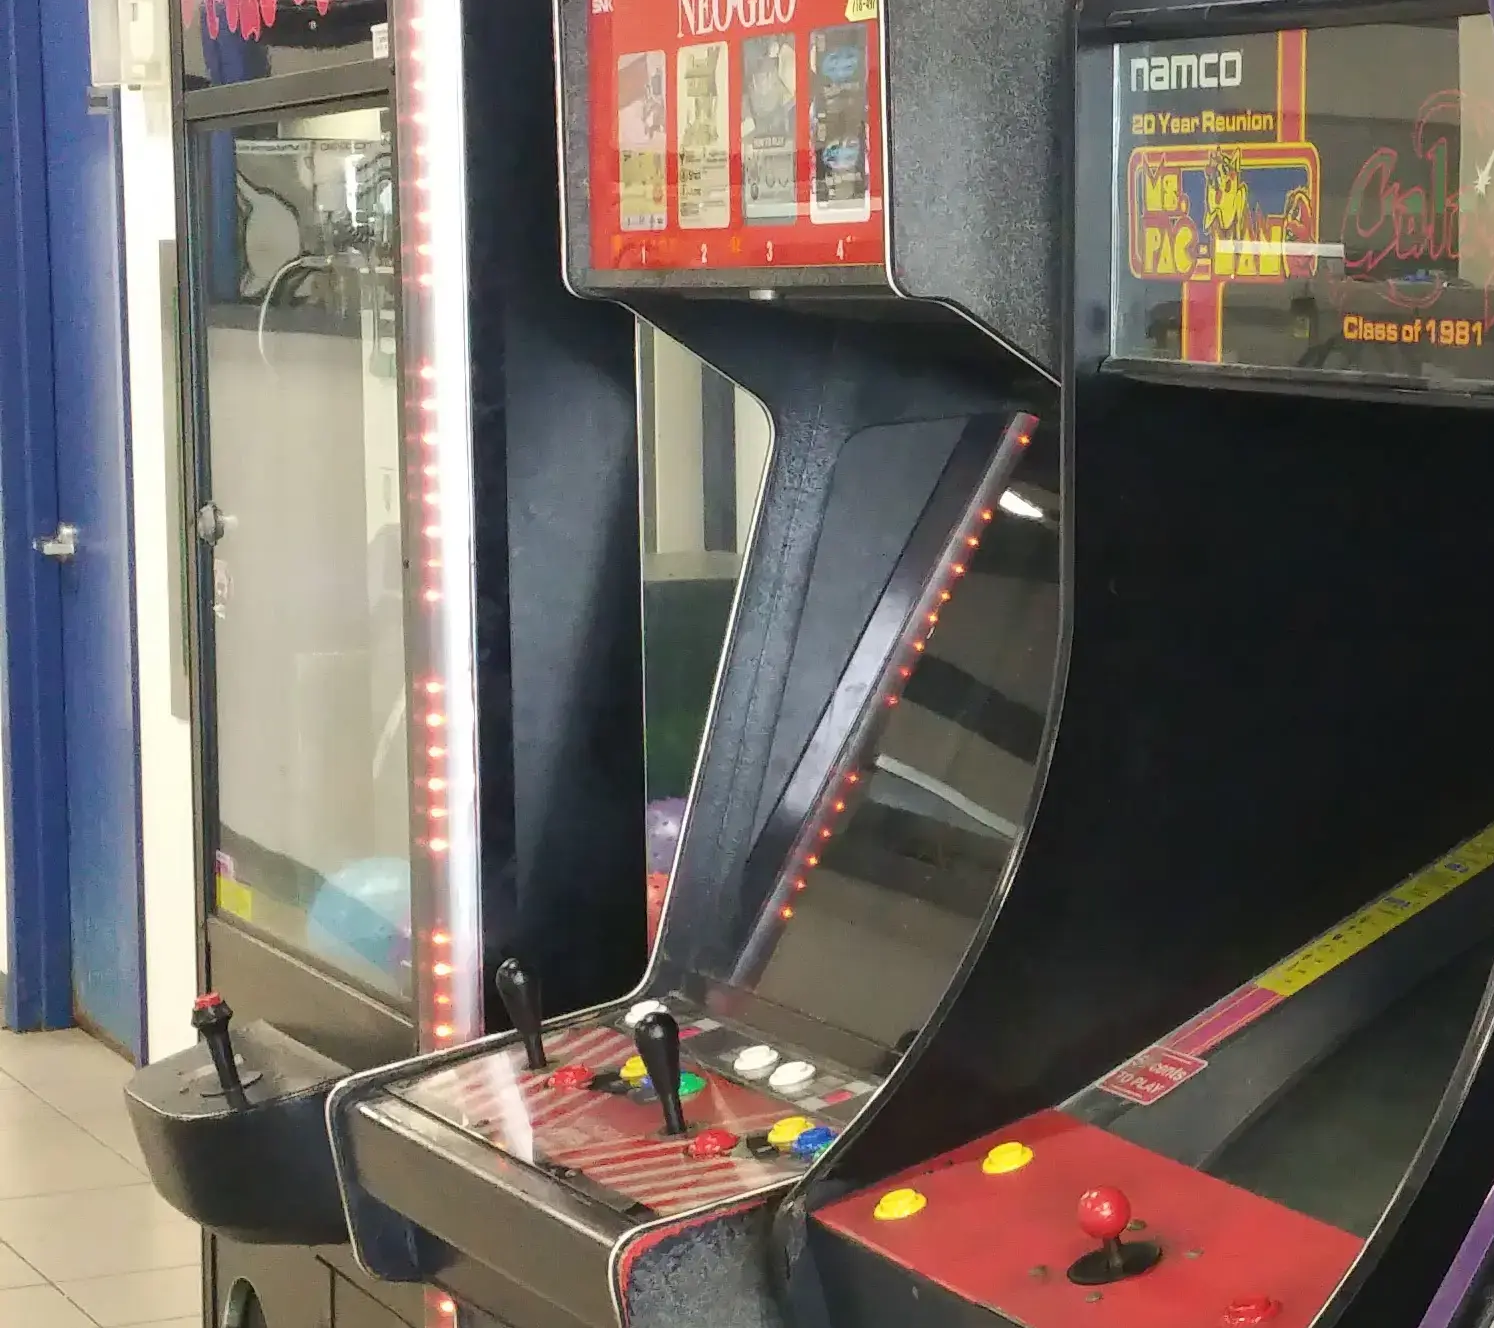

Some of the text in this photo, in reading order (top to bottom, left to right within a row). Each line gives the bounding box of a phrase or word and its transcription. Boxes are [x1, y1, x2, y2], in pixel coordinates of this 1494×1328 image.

[1130, 50, 1243, 92] namco
[1132, 108, 1276, 135] 20 Year Reunion
[700, 243, 708, 265] 2
[766, 240, 774, 262] 3
[836, 238, 845, 260] 4
[1342, 314, 1484, 347] Class of 1981
[1129, 1076, 1166, 1095] PLAY
